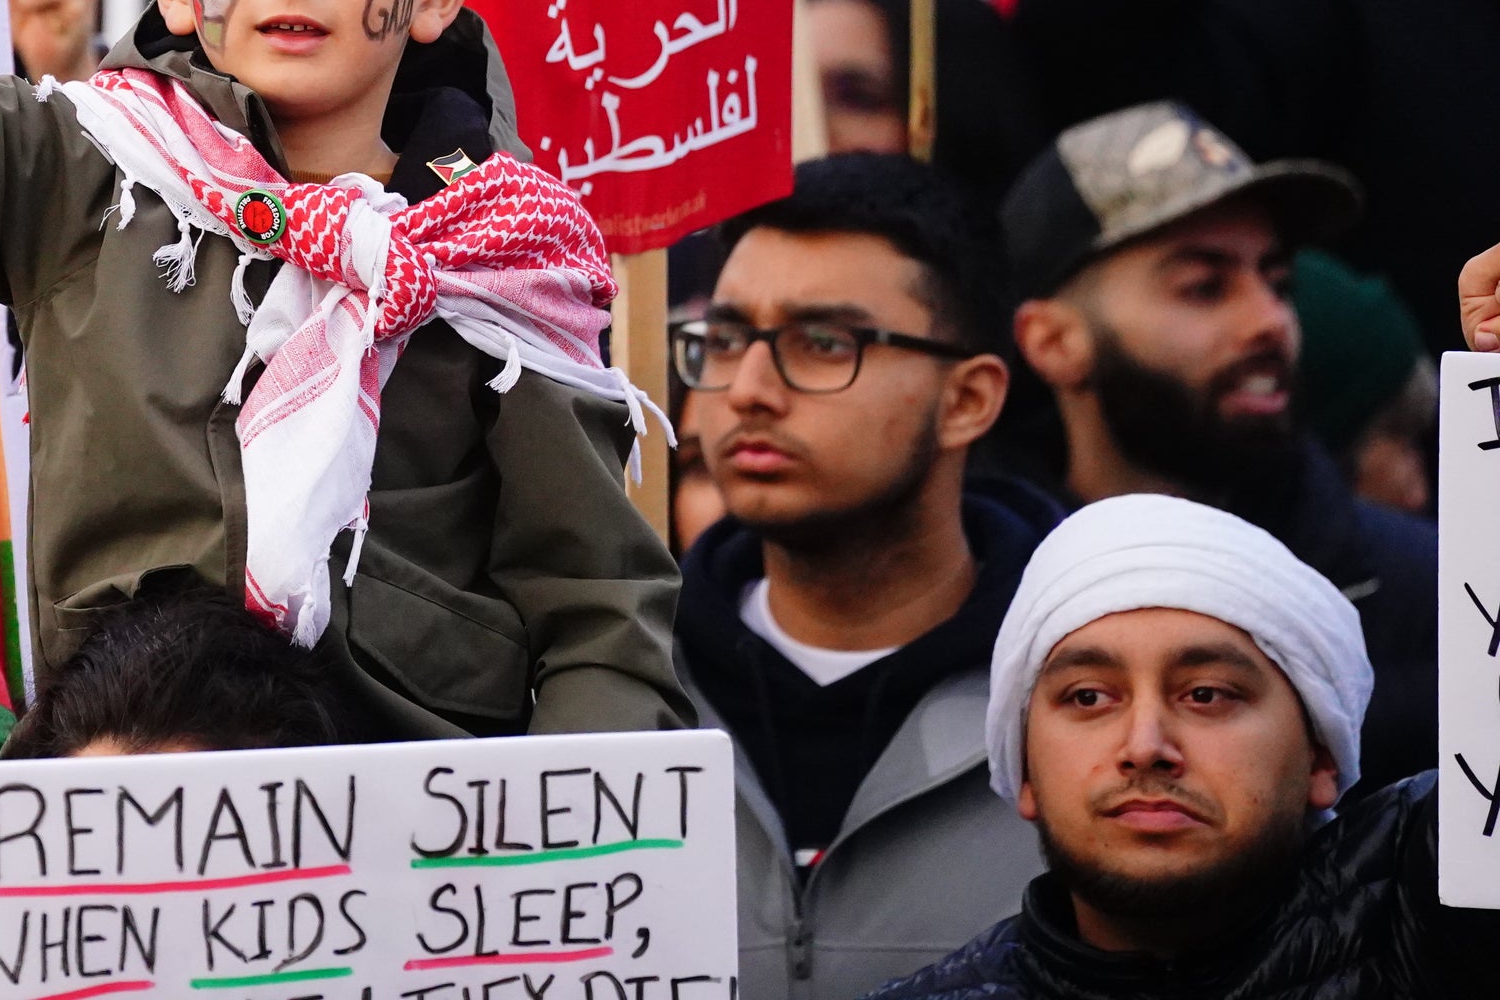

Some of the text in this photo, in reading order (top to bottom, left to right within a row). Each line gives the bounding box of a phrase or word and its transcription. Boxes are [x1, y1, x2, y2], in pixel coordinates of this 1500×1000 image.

[260, 229, 275, 240] FOR
[411, 766, 705, 857] SILENT
[201, 890, 368, 973] KIDS
[417, 873, 652, 959] SLEEP,
